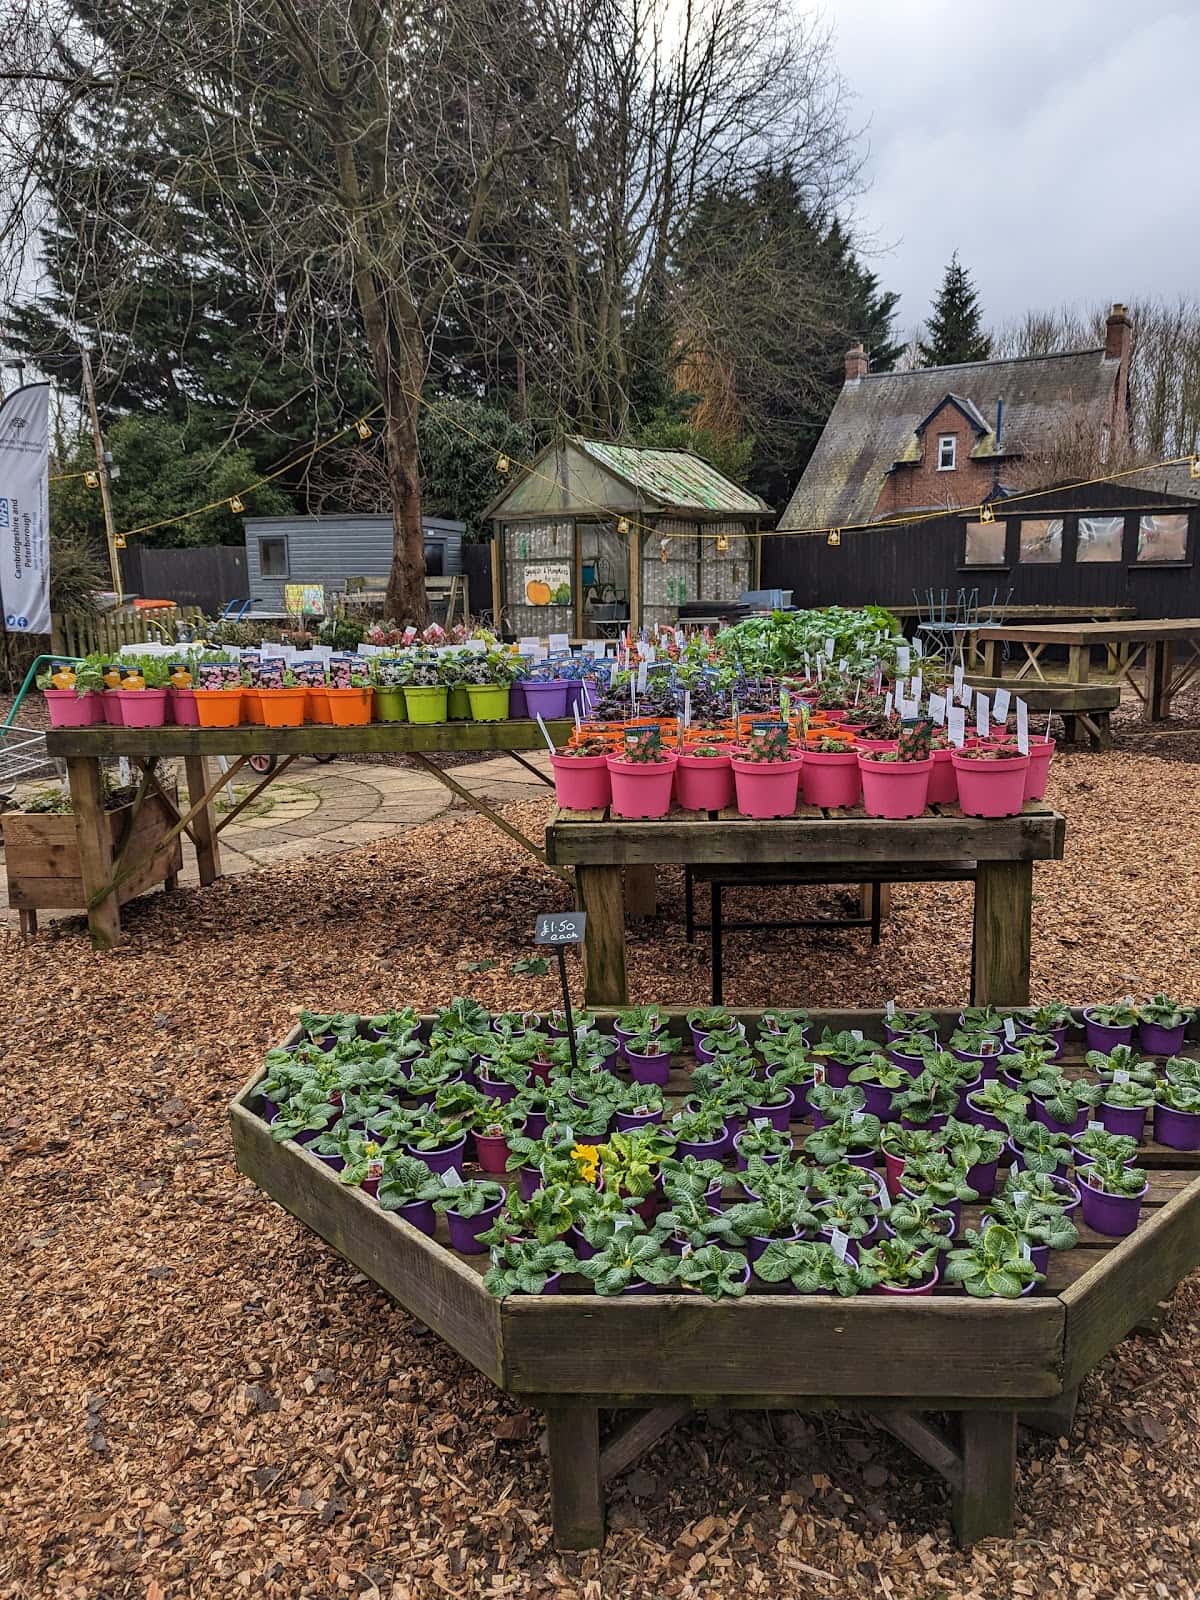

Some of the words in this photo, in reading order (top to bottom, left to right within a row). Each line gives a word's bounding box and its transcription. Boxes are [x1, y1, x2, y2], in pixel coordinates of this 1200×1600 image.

[0, 498, 8, 527] NHS
[10, 499, 18, 514] and
[11, 517, 22, 579] Cambridgeshire
[22, 512, 32, 568] Peterborough
[541, 920, 576, 936] £1.50
[551, 932, 578, 940] each
